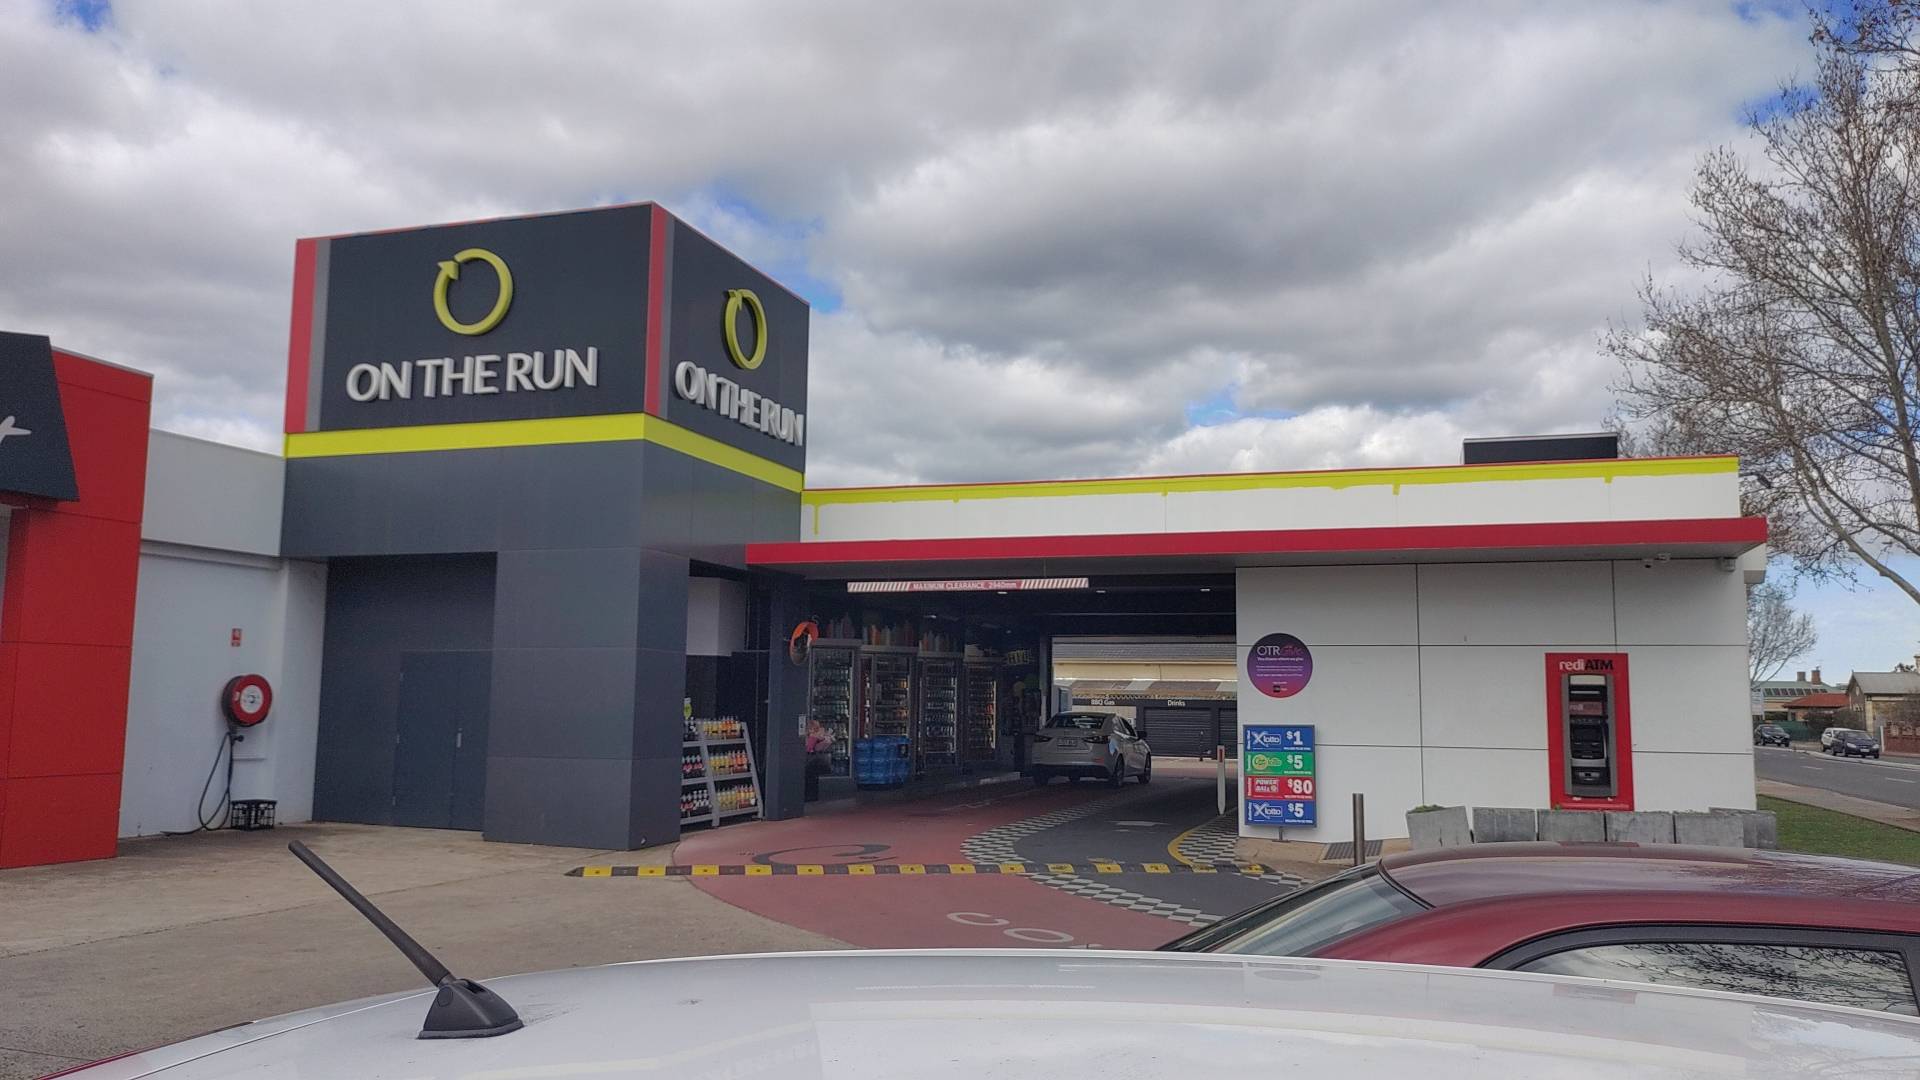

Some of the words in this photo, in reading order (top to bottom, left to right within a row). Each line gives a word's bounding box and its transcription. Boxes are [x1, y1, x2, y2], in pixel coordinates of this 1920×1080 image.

[346, 361, 412, 402] ON
[416, 355, 501, 398] THE
[506, 347, 598, 392] RUN
[675, 361, 717, 410] ON
[716, 377, 761, 429] THE
[760, 398, 804, 446] RUN
[912, 582, 945, 591] MAXIMUM
[945, 581, 984, 590] CLEARANCE
[1559, 658, 1614, 671] rediATM
[1167, 699, 1186, 707] Drinks
[1286, 730, 1304, 746] $1
[1286, 754, 1304, 770] $5
[1287, 778, 1313, 795] $80
[1288, 802, 1304, 818] $5
